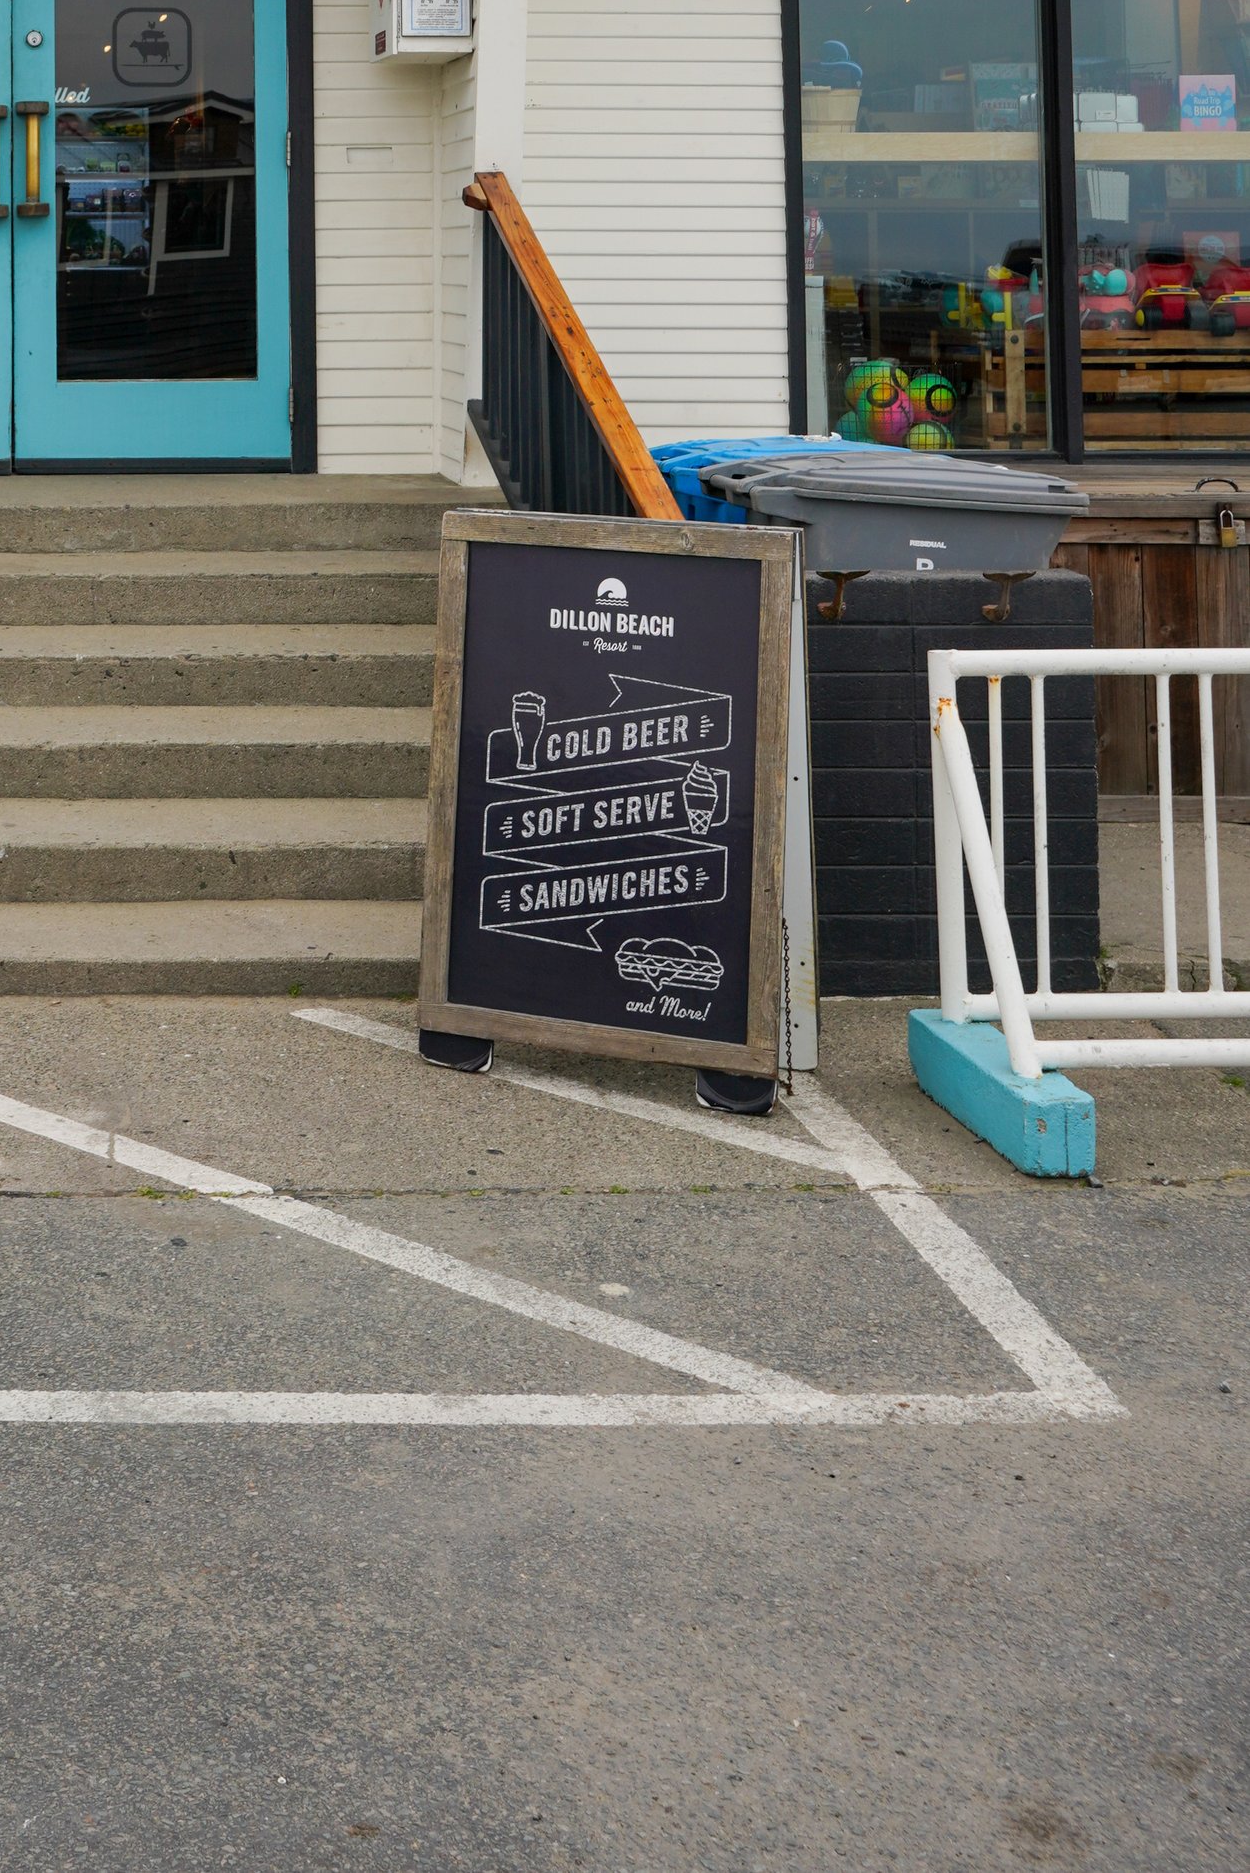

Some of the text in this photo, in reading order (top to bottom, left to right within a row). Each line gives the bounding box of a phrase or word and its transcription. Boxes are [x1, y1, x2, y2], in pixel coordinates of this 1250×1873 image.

[55, 86, 91, 104] lled
[1210, 97, 1221, 105] Trip
[1193, 106, 1222, 116] BINGO
[549, 608, 675, 638] DILLON BEACH
[593, 637, 628, 654] Resort
[546, 714, 690, 762] COLD BEER
[520, 790, 675, 839] SOFT SERVE
[518, 864, 691, 913] SANDWICHES
[626, 995, 711, 1023] and More!
